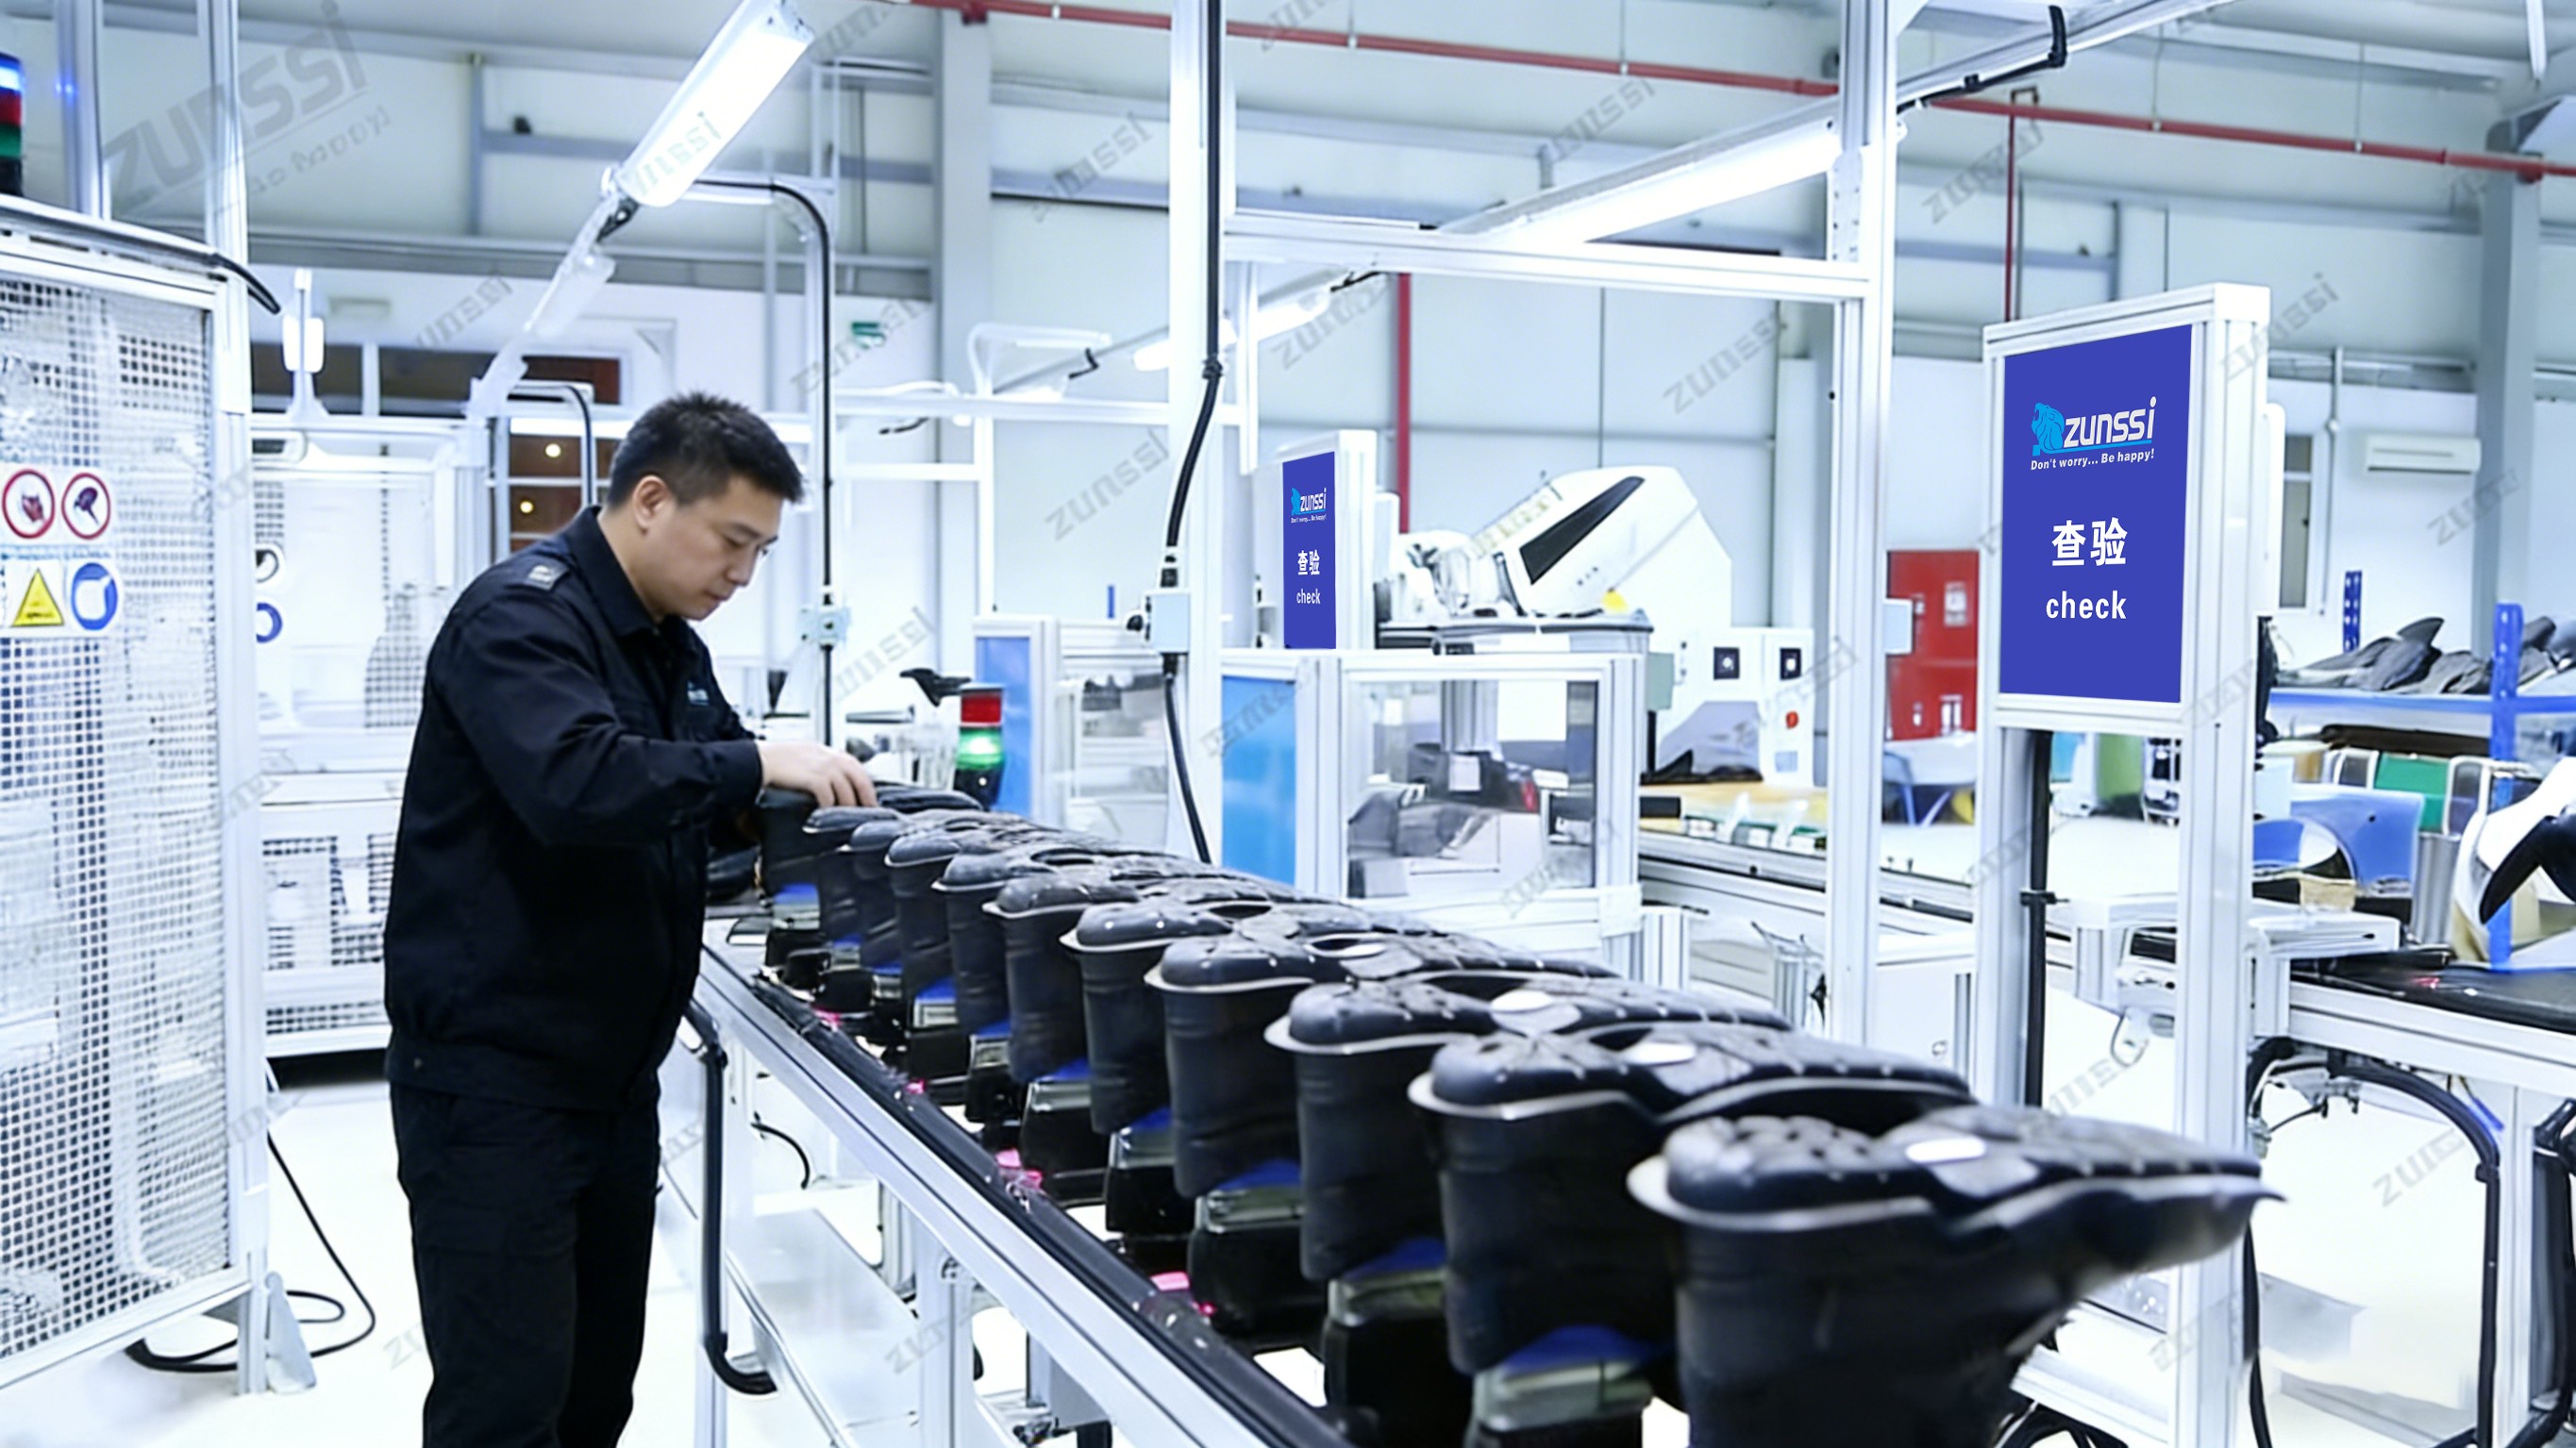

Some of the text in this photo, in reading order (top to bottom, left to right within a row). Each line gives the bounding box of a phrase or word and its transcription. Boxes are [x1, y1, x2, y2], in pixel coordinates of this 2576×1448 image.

[2031, 448, 2155, 470] Don't worry... Be happy!
[2051, 517, 2128, 566] 查验
[1297, 549, 1320, 575] 查验
[1296, 589, 1321, 604] check
[2046, 591, 2127, 619] check
